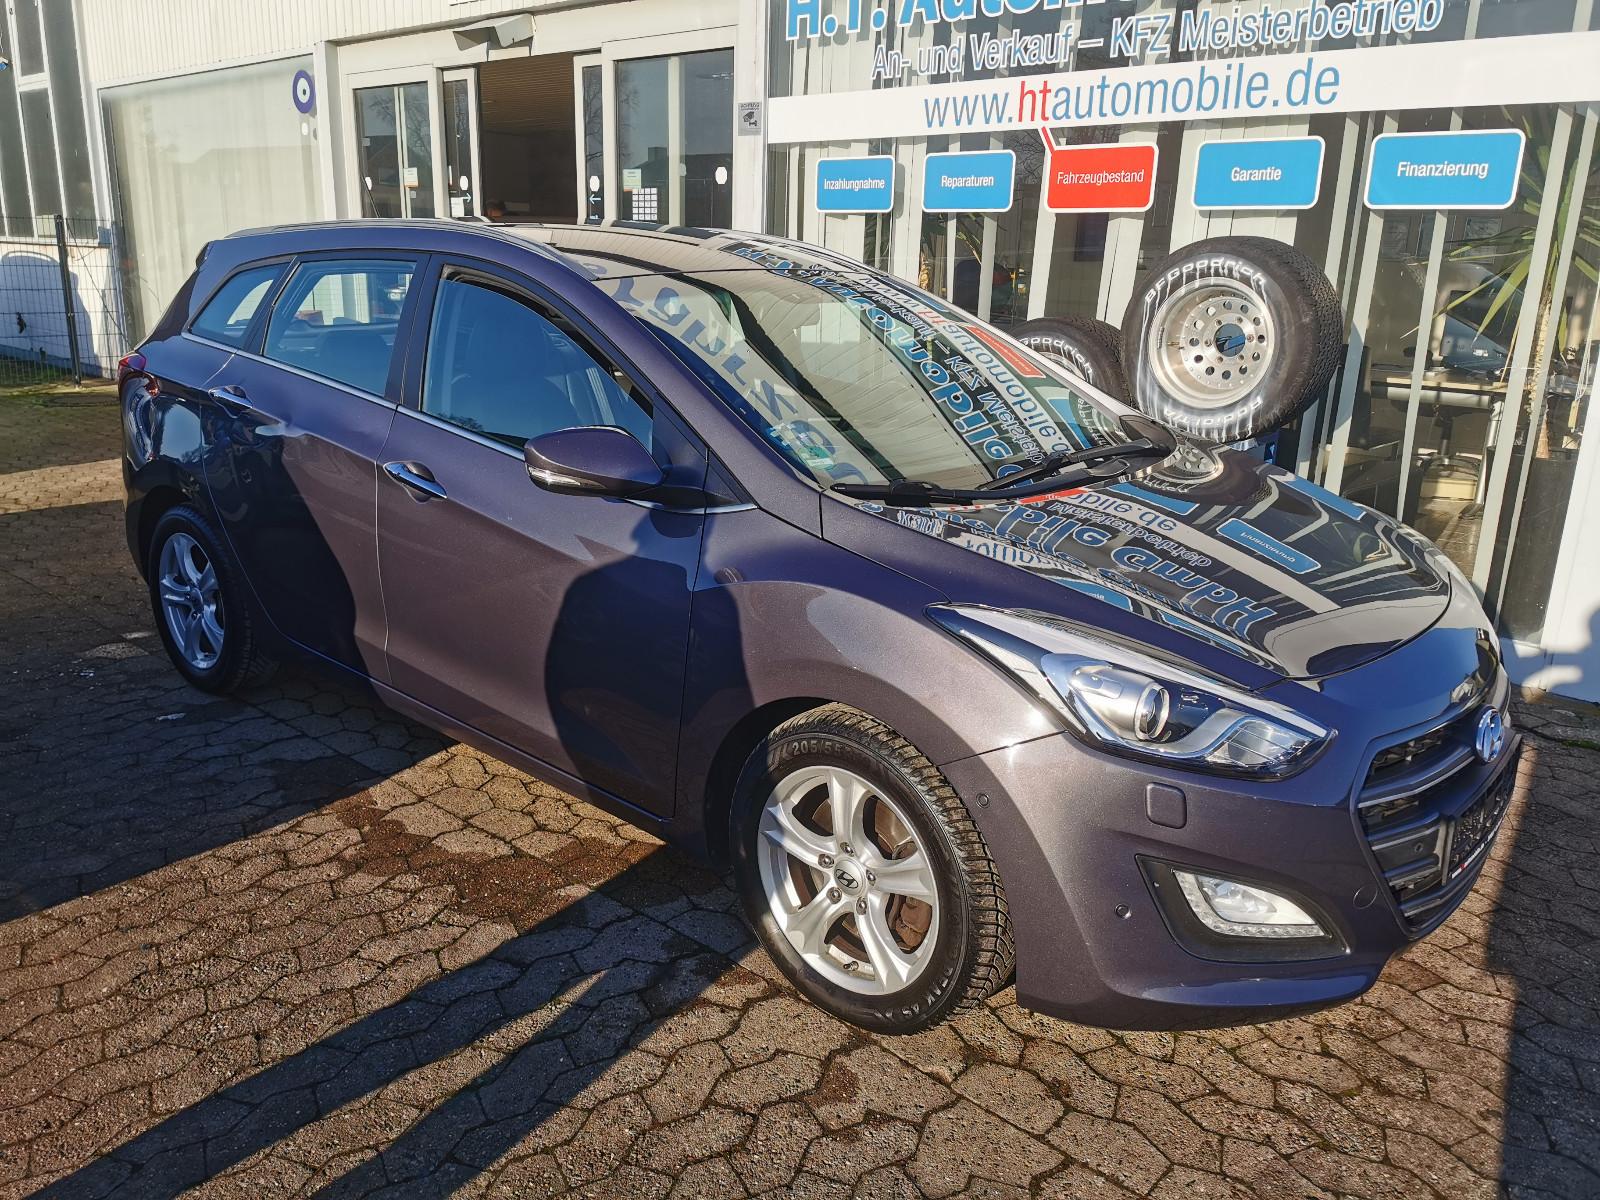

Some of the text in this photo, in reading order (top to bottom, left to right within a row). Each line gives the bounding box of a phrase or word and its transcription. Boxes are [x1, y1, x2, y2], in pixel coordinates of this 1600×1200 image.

[871, 45, 911, 80] An-
[918, 37, 965, 76] und
[970, 23, 1074, 71] Verkauf
[1109, 15, 1173, 59] KFZ
[1177, 0, 1445, 52] Meisterbetrieb
[924, 57, 1340, 128] www.htautomobile.de
[1057, 169, 1144, 186] Fahrzeugbestand
[1231, 167, 1281, 182] Garantie
[1397, 161, 1489, 179] Finanzierung
[824, 178, 886, 192] Inzahlungnahme
[941, 174, 994, 188] Reparaturen
[1144, 256, 1267, 303] BFGoodrich
